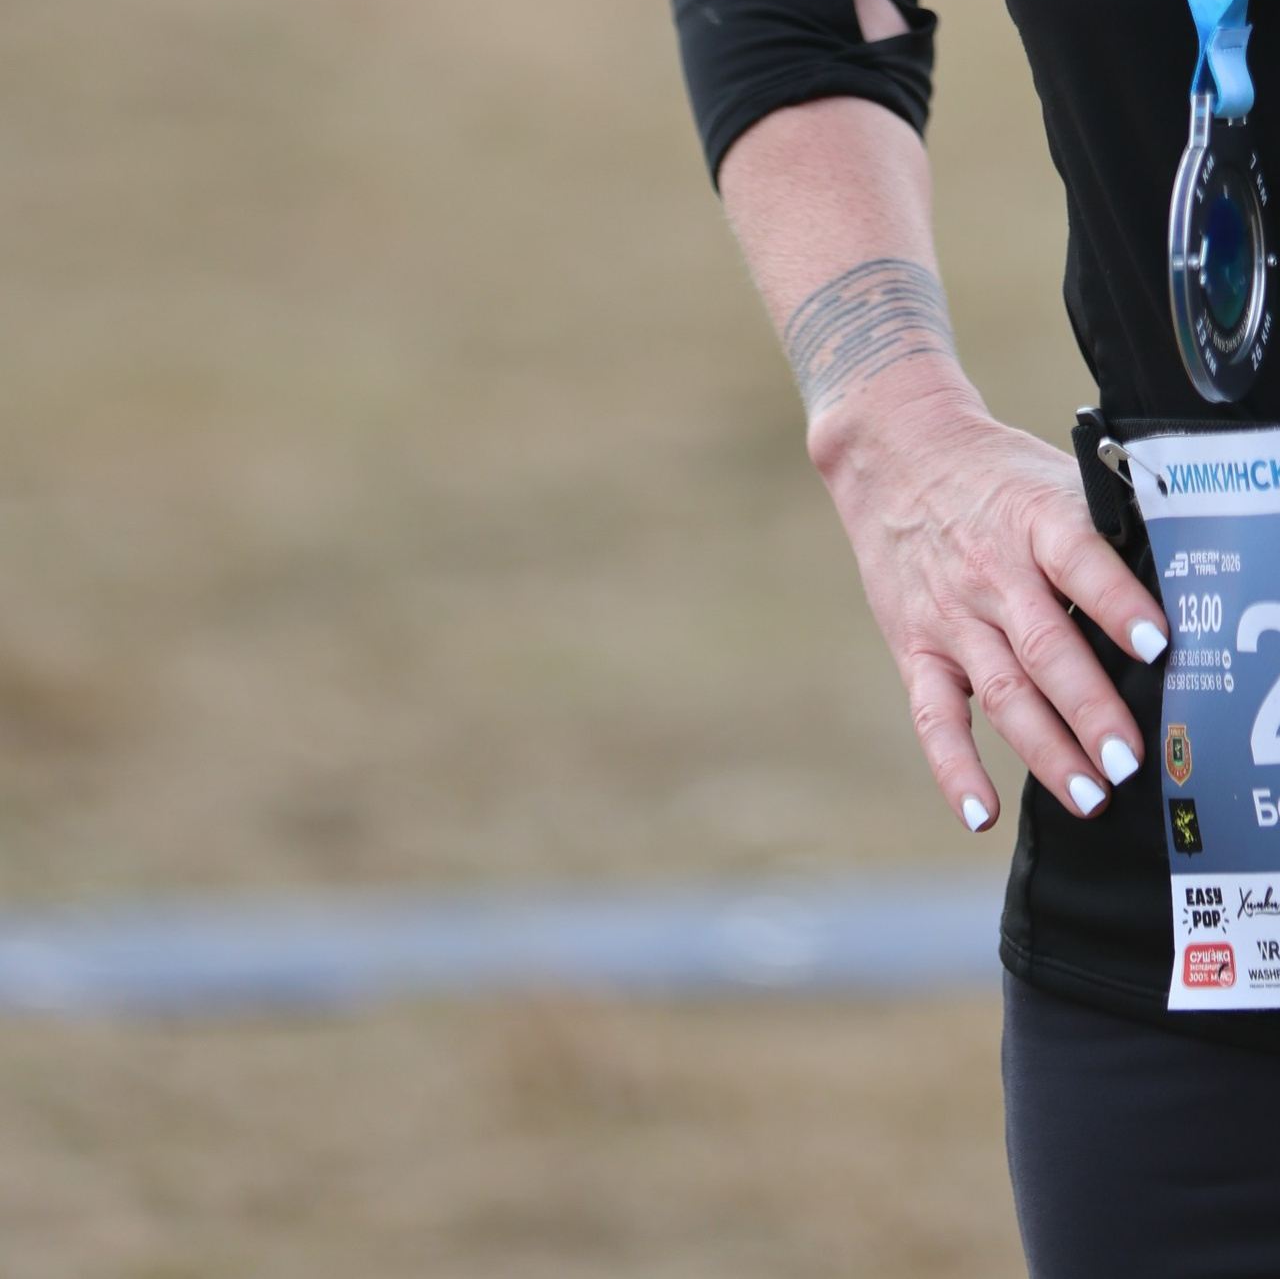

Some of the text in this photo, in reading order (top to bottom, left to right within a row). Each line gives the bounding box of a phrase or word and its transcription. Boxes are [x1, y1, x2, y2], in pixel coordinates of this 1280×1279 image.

[1221, 554, 1241, 573] 2026
[1185, 887, 1223, 906] EASY
[1192, 910, 1222, 929] POP
